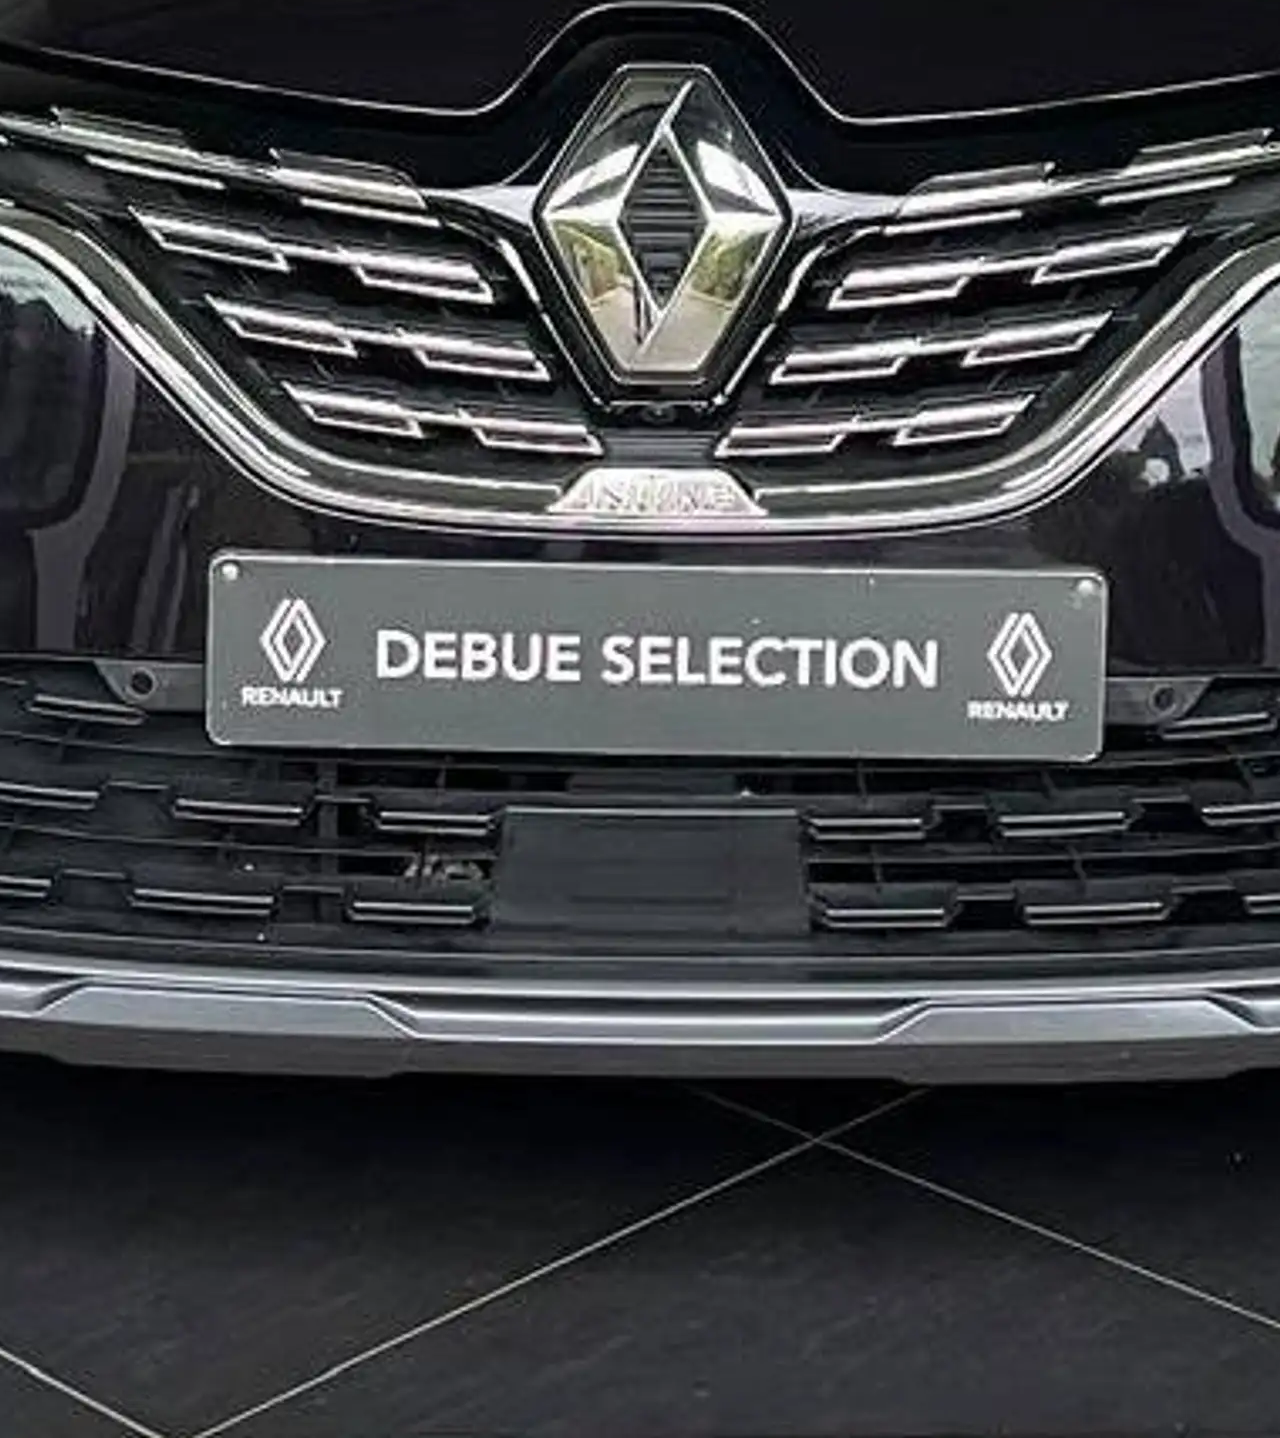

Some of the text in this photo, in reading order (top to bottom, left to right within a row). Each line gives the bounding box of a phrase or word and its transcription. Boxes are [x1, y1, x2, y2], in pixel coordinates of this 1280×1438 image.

[375, 628, 939, 689] DEBUE SELECTION
[239, 684, 344, 709] RENAULT
[966, 699, 1070, 723] RENAULT
